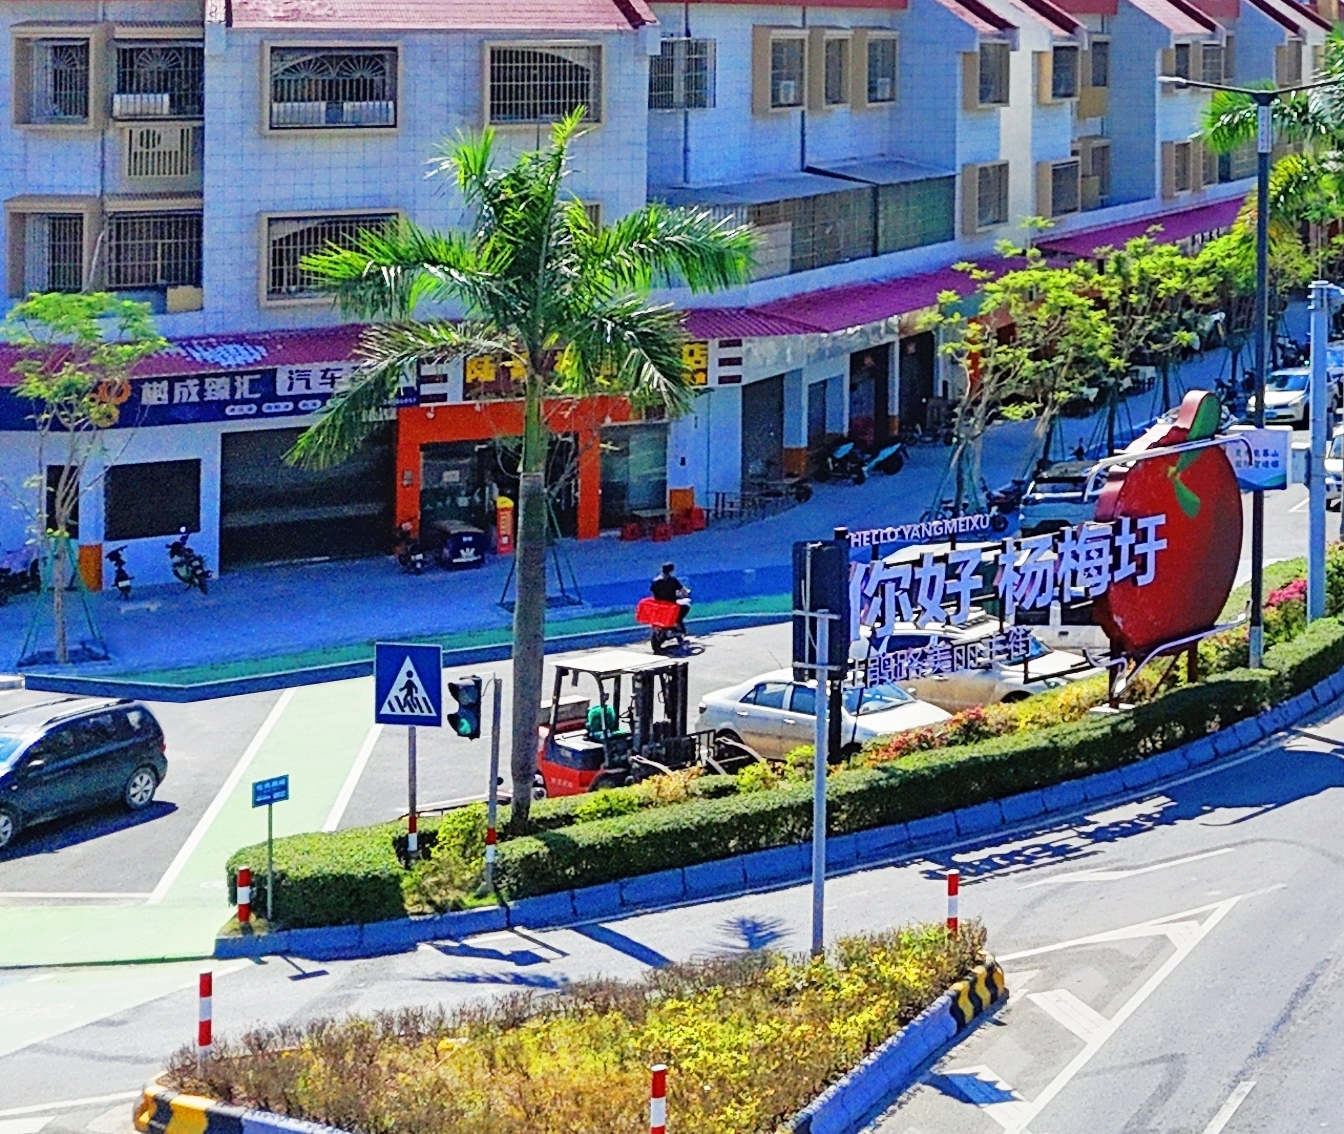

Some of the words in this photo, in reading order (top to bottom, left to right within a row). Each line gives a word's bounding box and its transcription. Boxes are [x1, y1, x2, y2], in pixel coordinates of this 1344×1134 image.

[848, 527, 900, 548] HELLO
[900, 514, 992, 541] YANGMEIXU
[848, 548, 984, 642] 你好
[998, 513, 1168, 617] 杨梅圩
